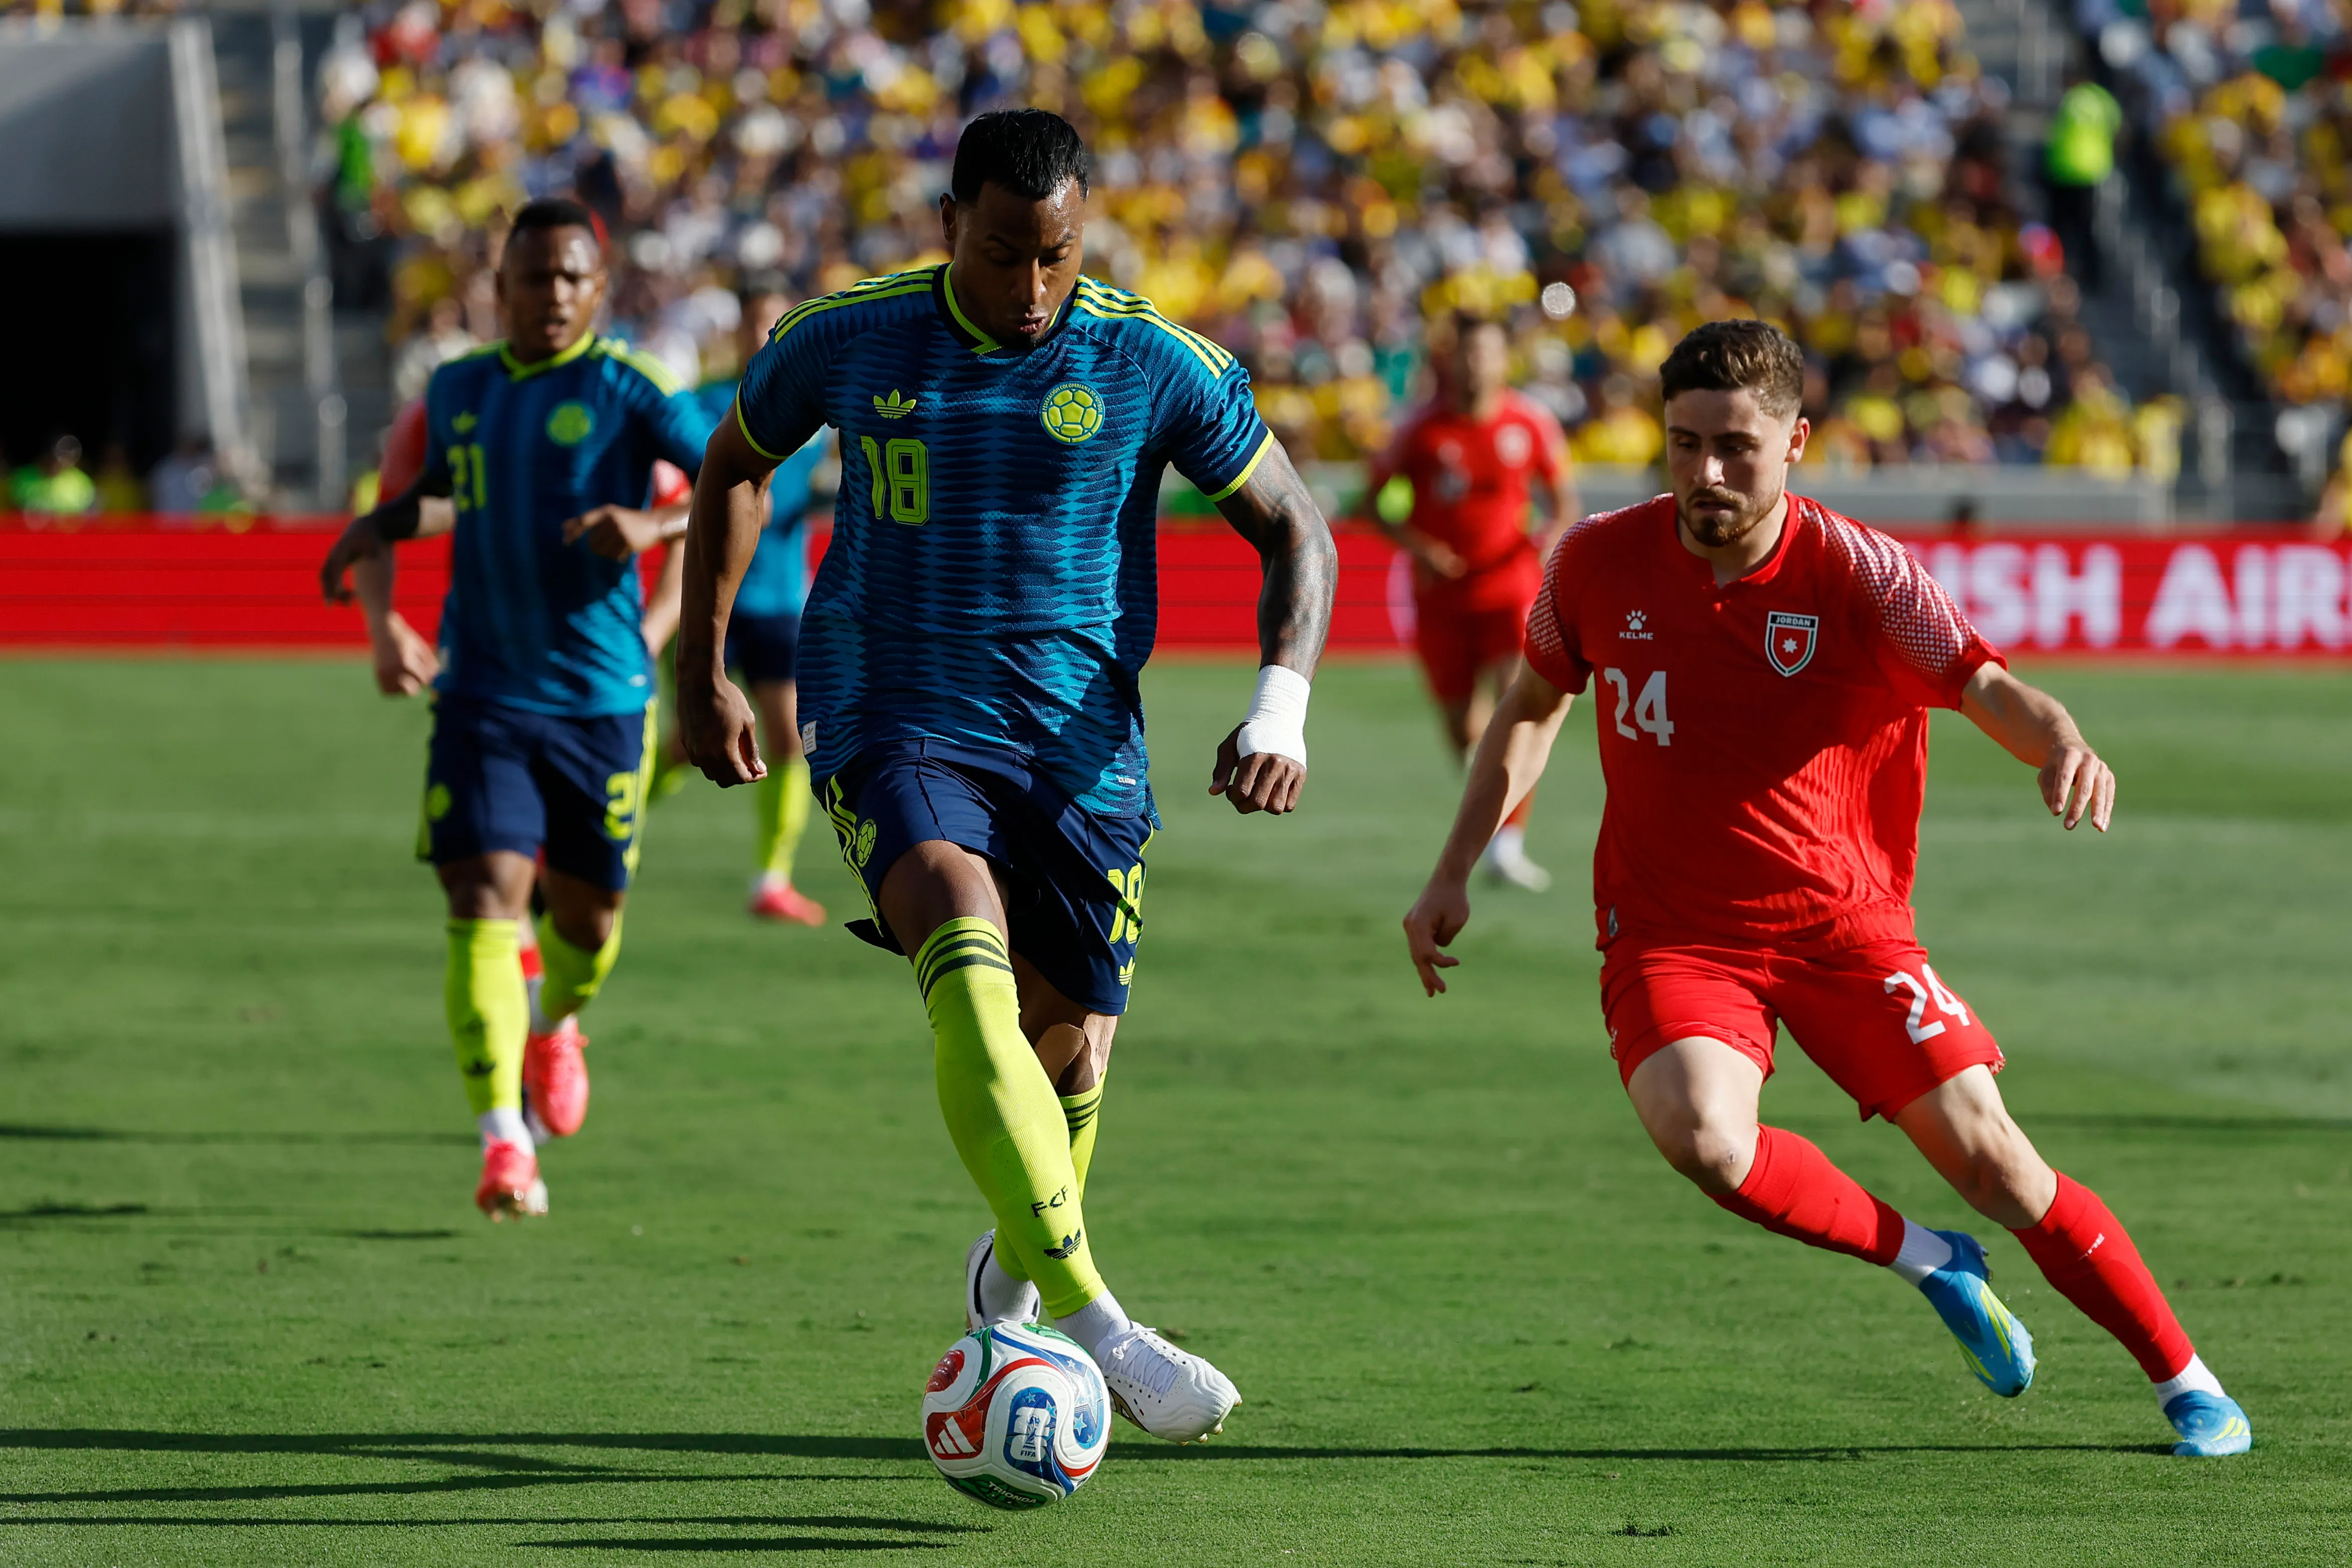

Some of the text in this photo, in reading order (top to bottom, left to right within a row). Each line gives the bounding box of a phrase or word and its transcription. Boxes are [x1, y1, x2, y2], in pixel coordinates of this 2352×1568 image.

[446, 443, 486, 512] 21
[860, 436, 930, 526] 18
[1776, 616, 1811, 626] JORDAN
[1907, 542, 2352, 648] ISH AIR
[1619, 632, 1653, 640] KELME
[1604, 667, 1674, 746] 24
[1884, 964, 1970, 1045] 24
[1031, 1184, 1068, 1217] FCF
[988, 1481, 1036, 1503] TRIONDA
